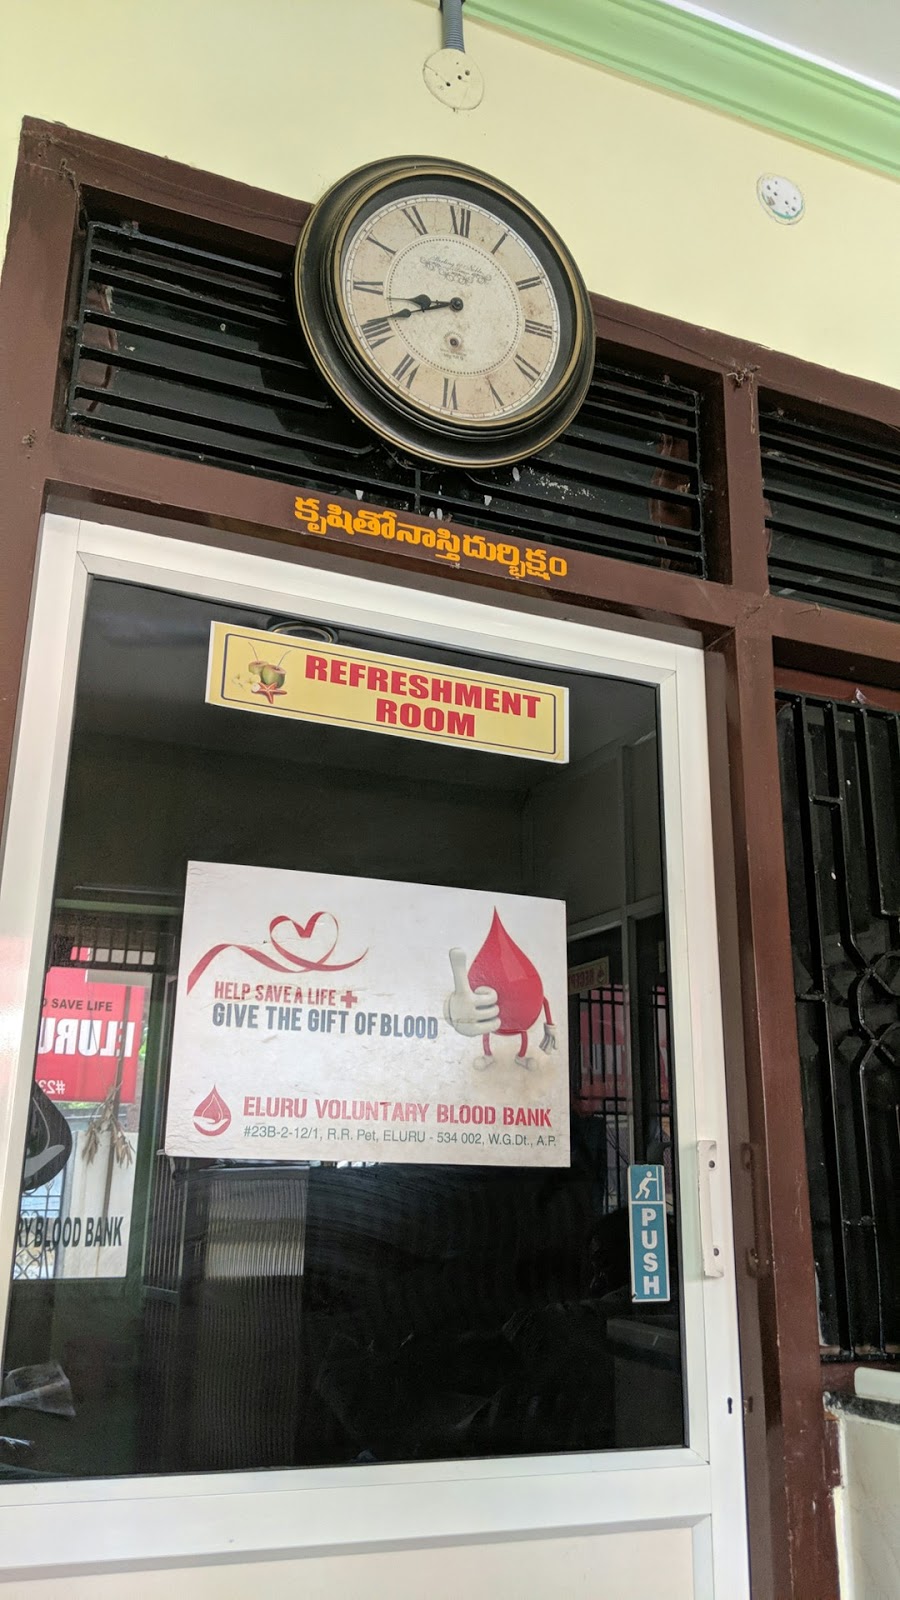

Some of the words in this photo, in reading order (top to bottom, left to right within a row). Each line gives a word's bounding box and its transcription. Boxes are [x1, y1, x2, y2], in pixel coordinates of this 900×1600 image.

[524, 319, 553, 339] III
[304, 654, 542, 719] REFRESHMENT
[375, 697, 476, 738] ROOM
[51, 998, 83, 1010] SAVE
[87, 1001, 113, 1012] LIFE
[214, 981, 251, 1000] HELP
[255, 985, 293, 1003] SAVE
[293, 986, 301, 1005] A
[307, 988, 337, 1006] LIFE
[212, 1003, 260, 1028] GIVE
[266, 1006, 301, 1031] THE
[307, 1009, 349, 1034] GIFT
[354, 1011, 378, 1035] OF
[379, 1013, 439, 1039] BLOOD
[243, 1096, 308, 1118] ELURU
[315, 1099, 430, 1123] VOLUNTARY
[436, 1103, 496, 1125] BLOOD
[503, 1106, 553, 1128] BANK
[243, 1125, 324, 1142] #23B-2-12/1,
[327, 1128, 354, 1141] R.R.
[356, 1129, 379, 1143] Pet,
[383, 1130, 426, 1143] ELURU
[436, 1131, 458, 1144] 534
[461, 1132, 485, 1146] 002,
[488, 1133, 533, 1148] W.G.Dt.,
[536, 1135, 557, 1147] A.P.
[34, 1216, 82, 1248] BLOOD
[84, 1216, 124, 1247] BANK
[641, 1207, 660, 1295] PUSH
